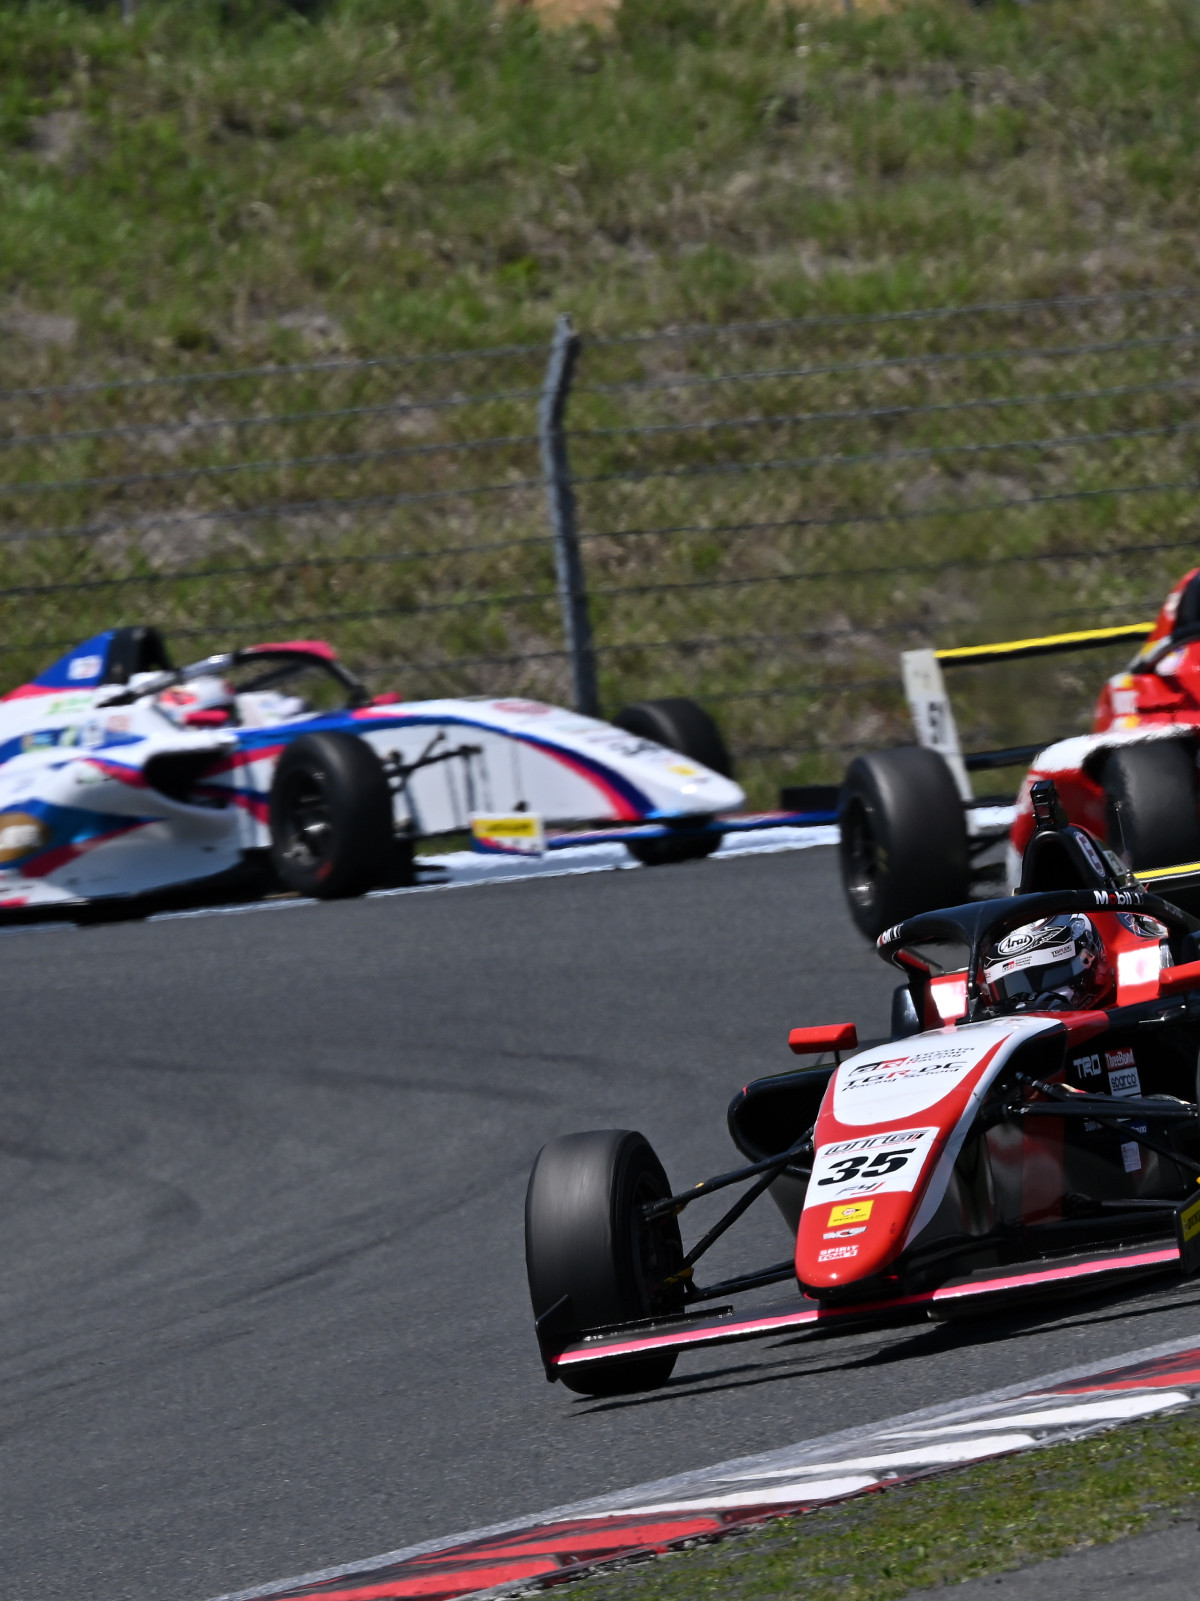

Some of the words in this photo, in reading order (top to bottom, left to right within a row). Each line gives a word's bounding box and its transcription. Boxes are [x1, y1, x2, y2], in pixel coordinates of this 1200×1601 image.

[1094, 890, 1133, 905] Mobil
[1006, 934, 1028, 950] Arai
[1073, 1053, 1102, 1079] TRD
[817, 1147, 917, 1187] 35
[820, 1245, 859, 1257] SPIRIT
